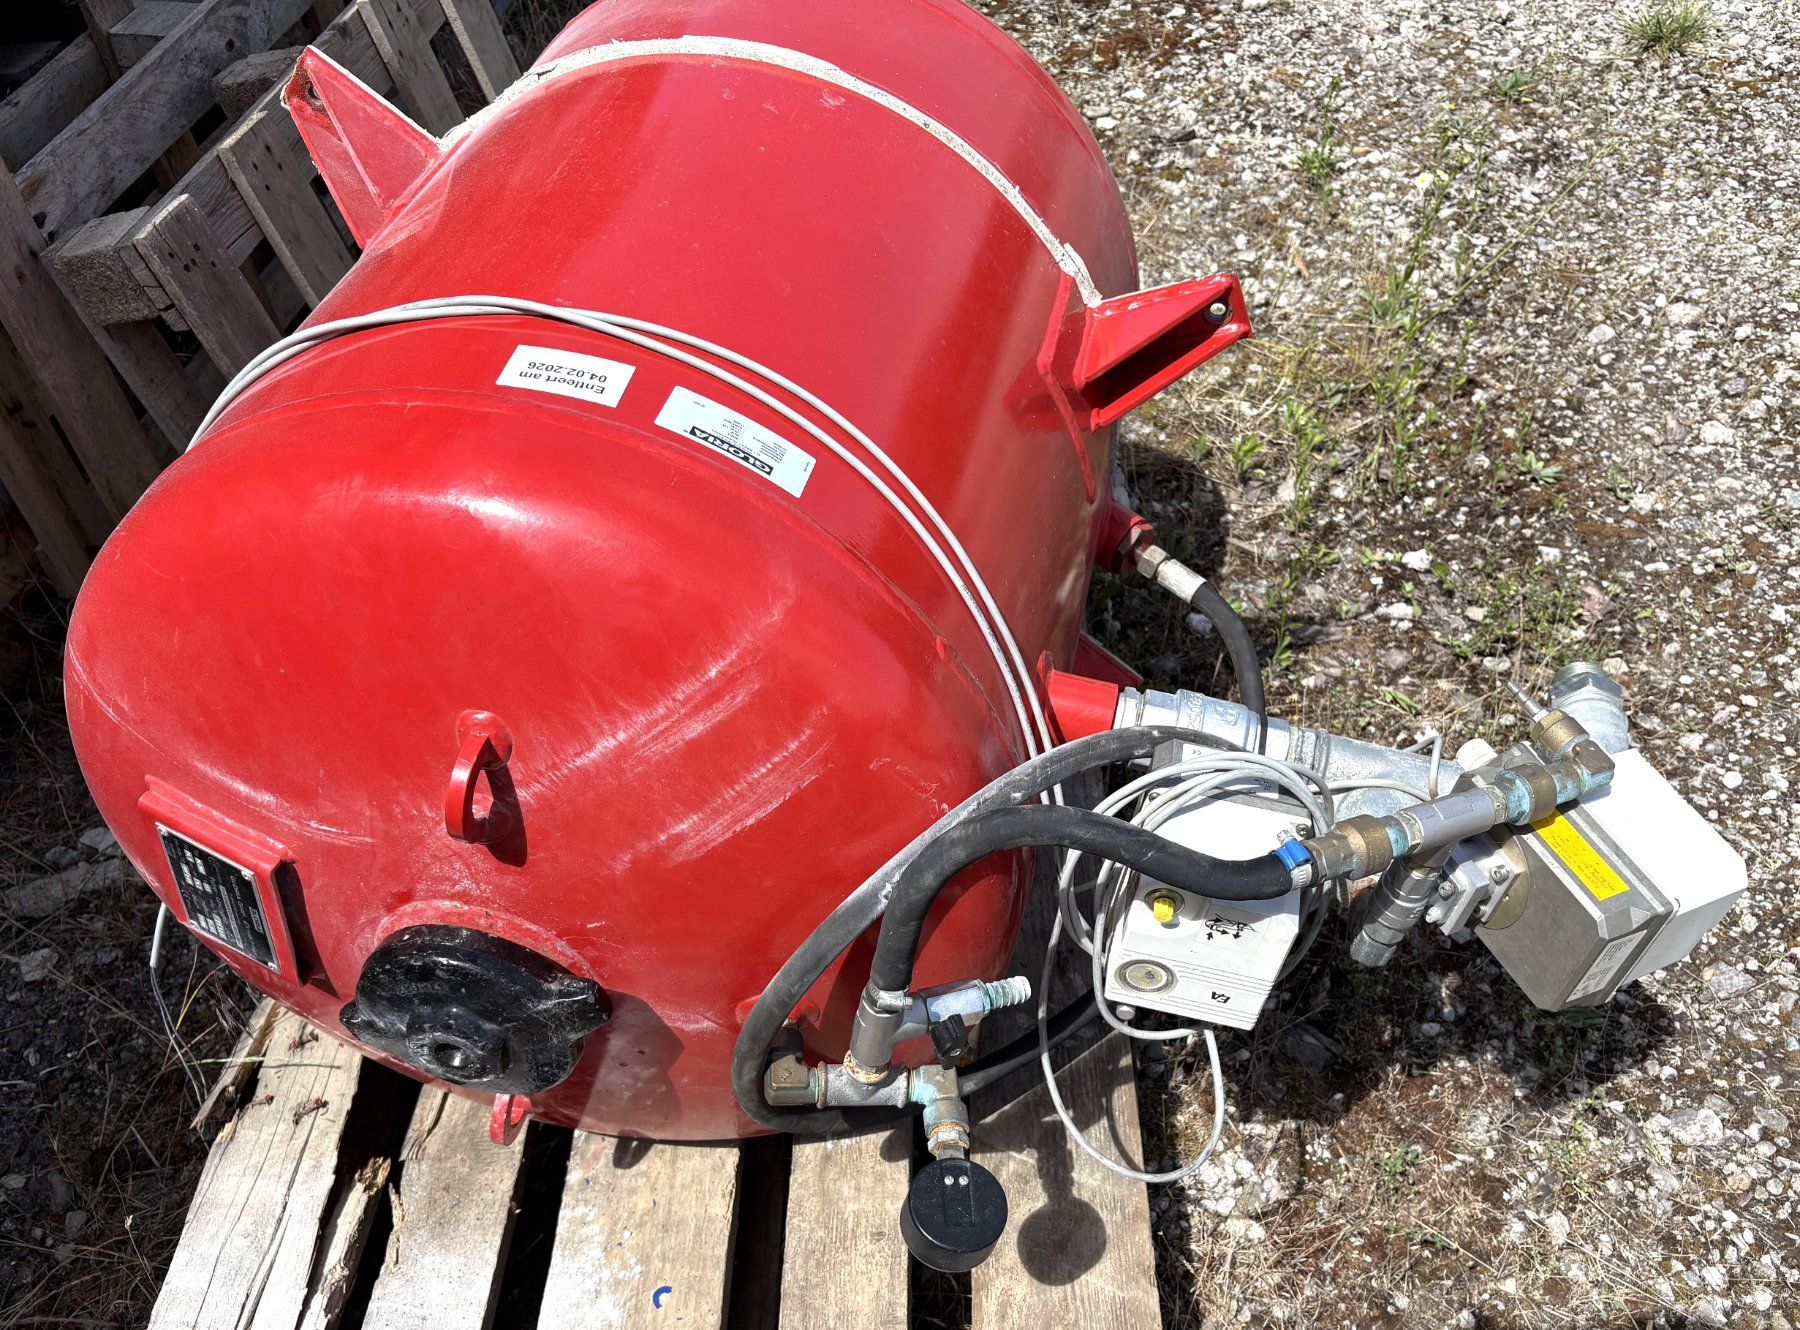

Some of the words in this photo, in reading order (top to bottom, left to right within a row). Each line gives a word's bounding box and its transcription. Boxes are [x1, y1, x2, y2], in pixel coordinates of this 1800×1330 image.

[519, 371, 542, 380] am
[527, 361, 607, 383] 04.02.2026
[546, 375, 606, 394] Entleert
[691, 427, 773, 475] GLORIA
[230, 875, 241, 900] GLORIA
